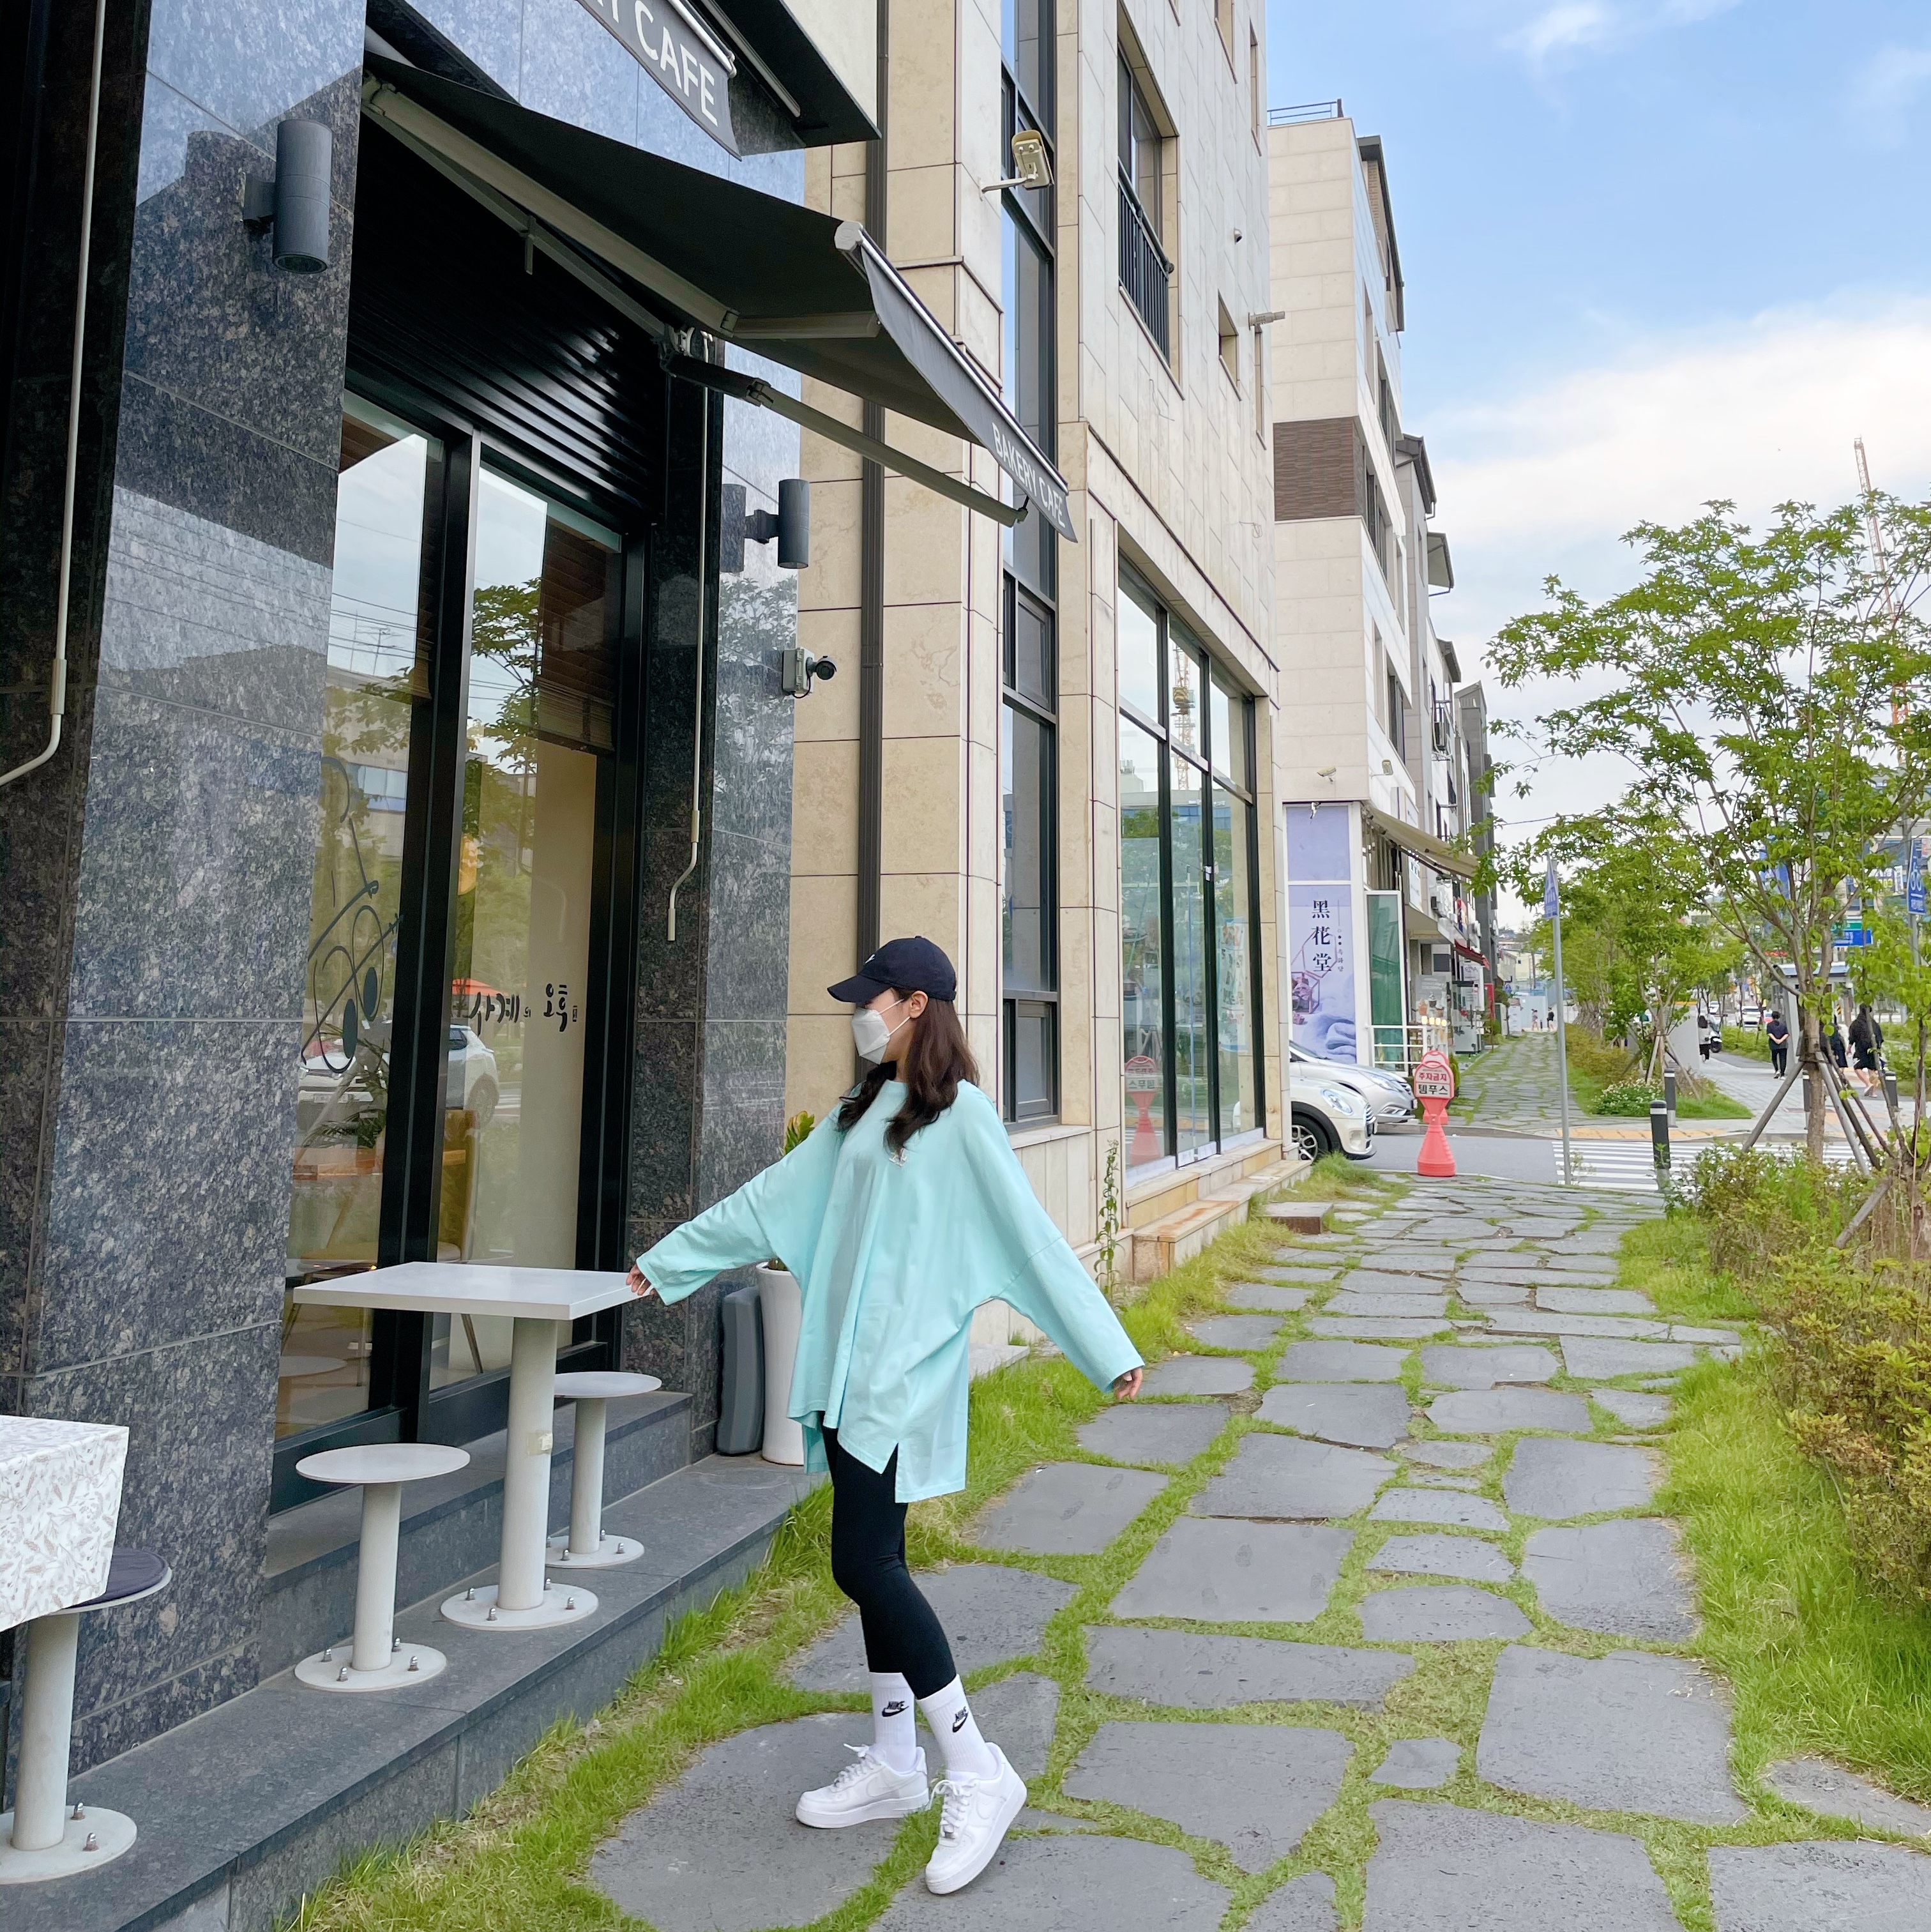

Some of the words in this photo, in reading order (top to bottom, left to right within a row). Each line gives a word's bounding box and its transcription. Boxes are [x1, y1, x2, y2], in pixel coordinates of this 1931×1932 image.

[635, 0, 718, 127] CAFE
[992, 422, 1037, 497] BAKERY
[1039, 476, 1065, 528] CAFE
